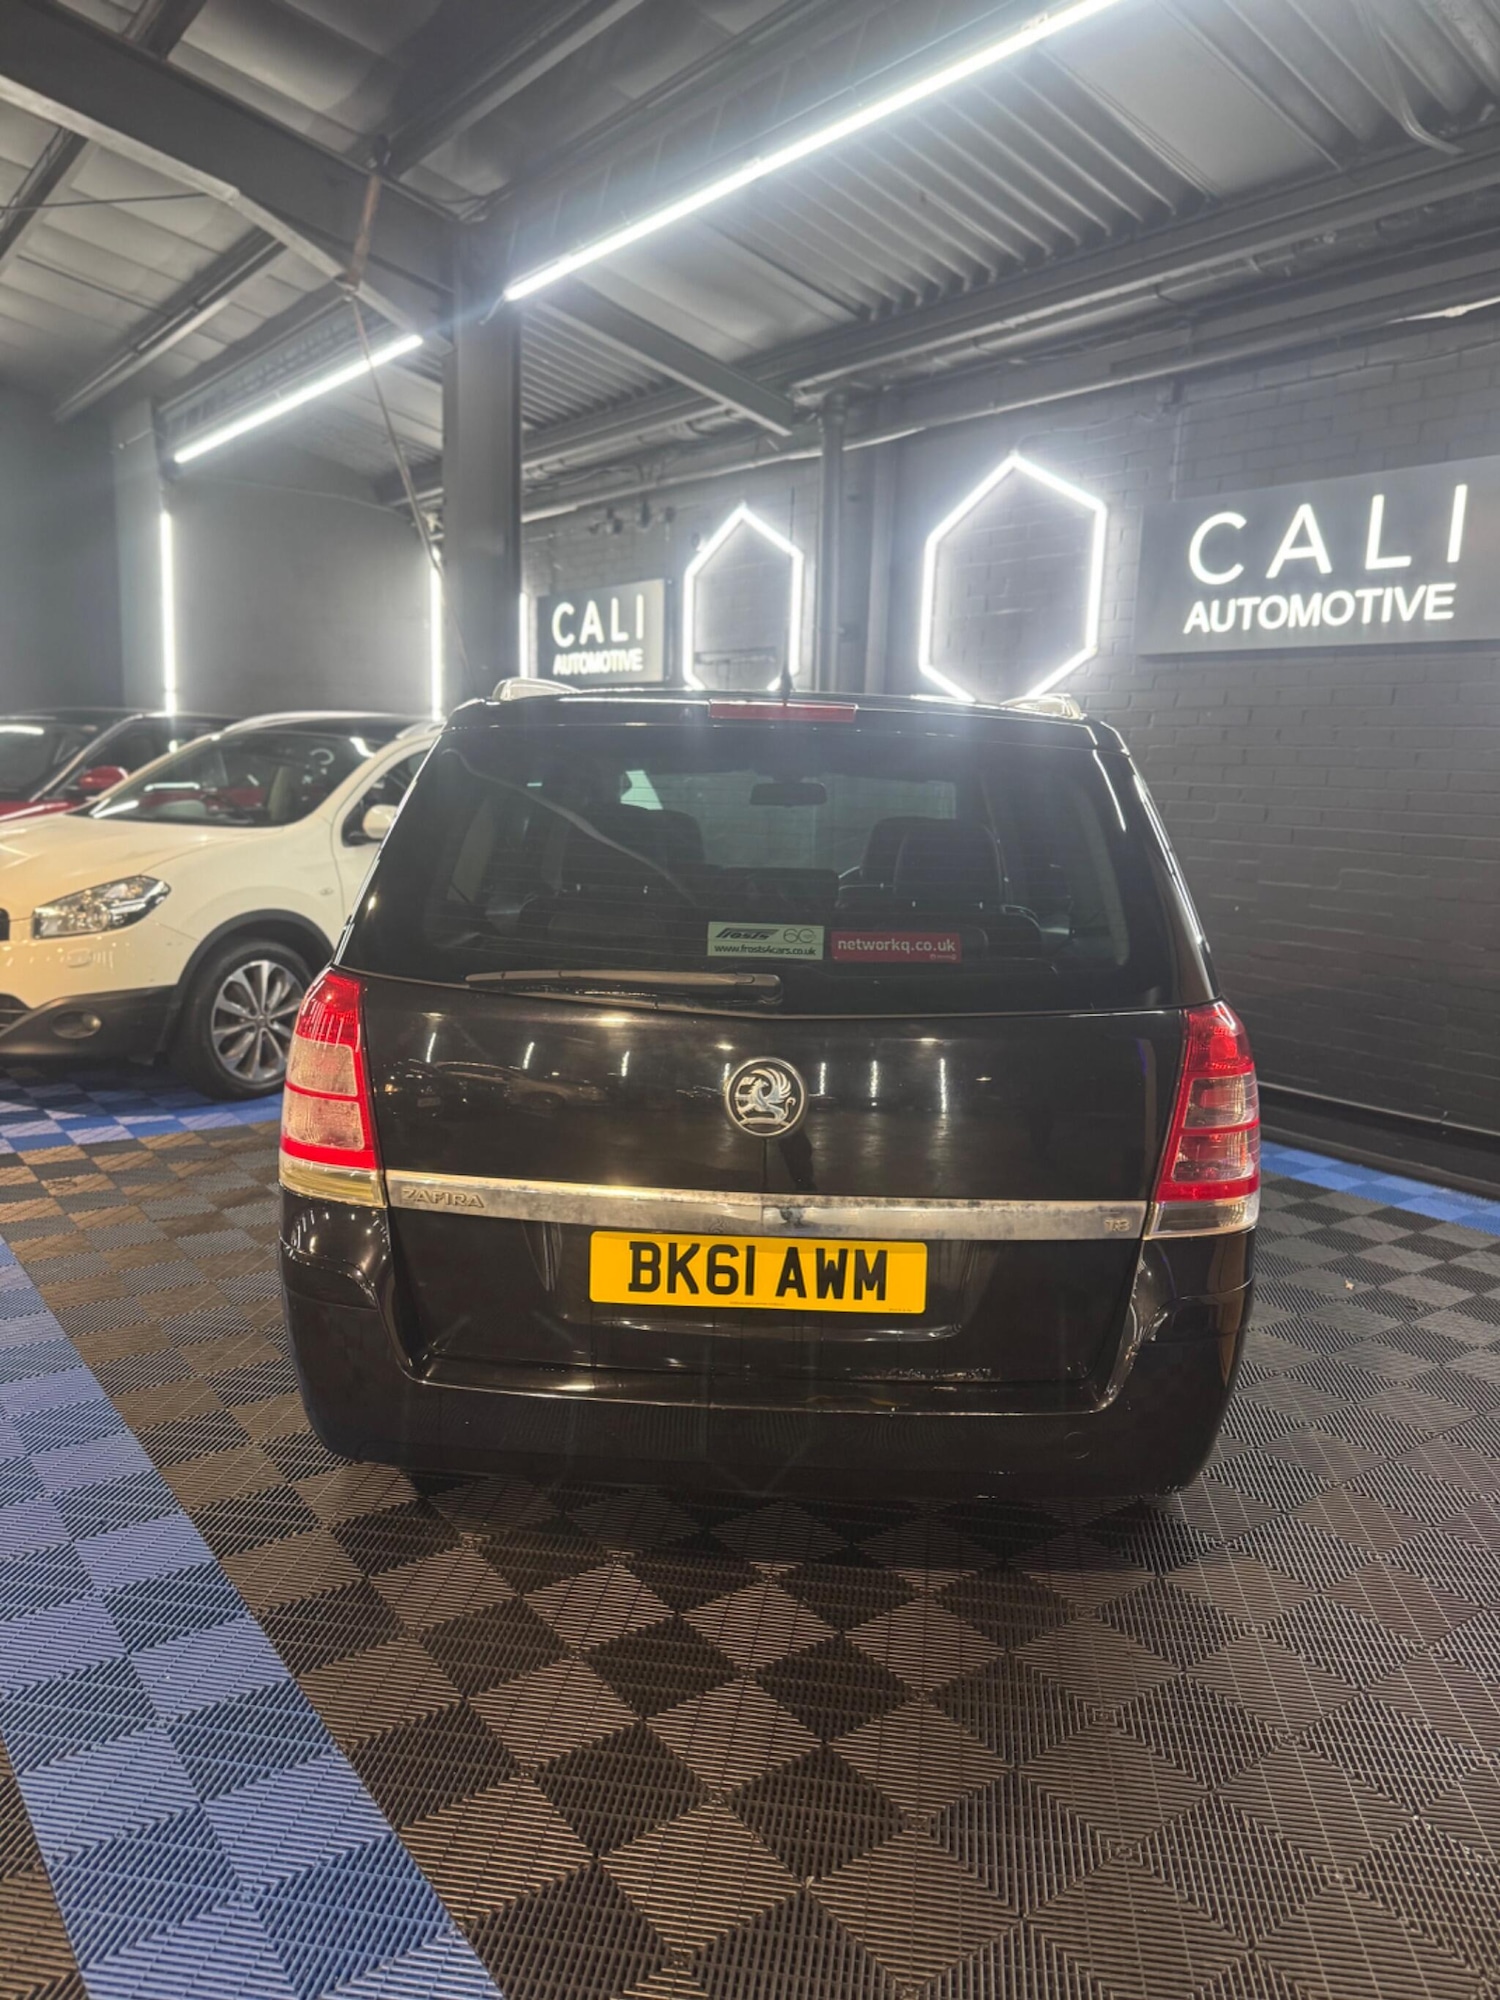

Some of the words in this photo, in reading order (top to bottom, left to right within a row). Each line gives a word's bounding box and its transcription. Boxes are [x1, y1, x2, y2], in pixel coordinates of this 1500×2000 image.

[1189, 484, 1468, 585] CALI
[552, 594, 644, 648] CALI
[1183, 583, 1457, 634] AUTOMOTIVE
[552, 648, 644, 676] AUTOMOTIVE
[713, 944, 817, 956] www.frosts4cars.co.uk
[837, 938, 956, 954] networkq.co.uk
[402, 1187, 486, 1208] ZAFIRA
[628, 1241, 756, 1297] BK61
[775, 1246, 888, 1301] AWM
